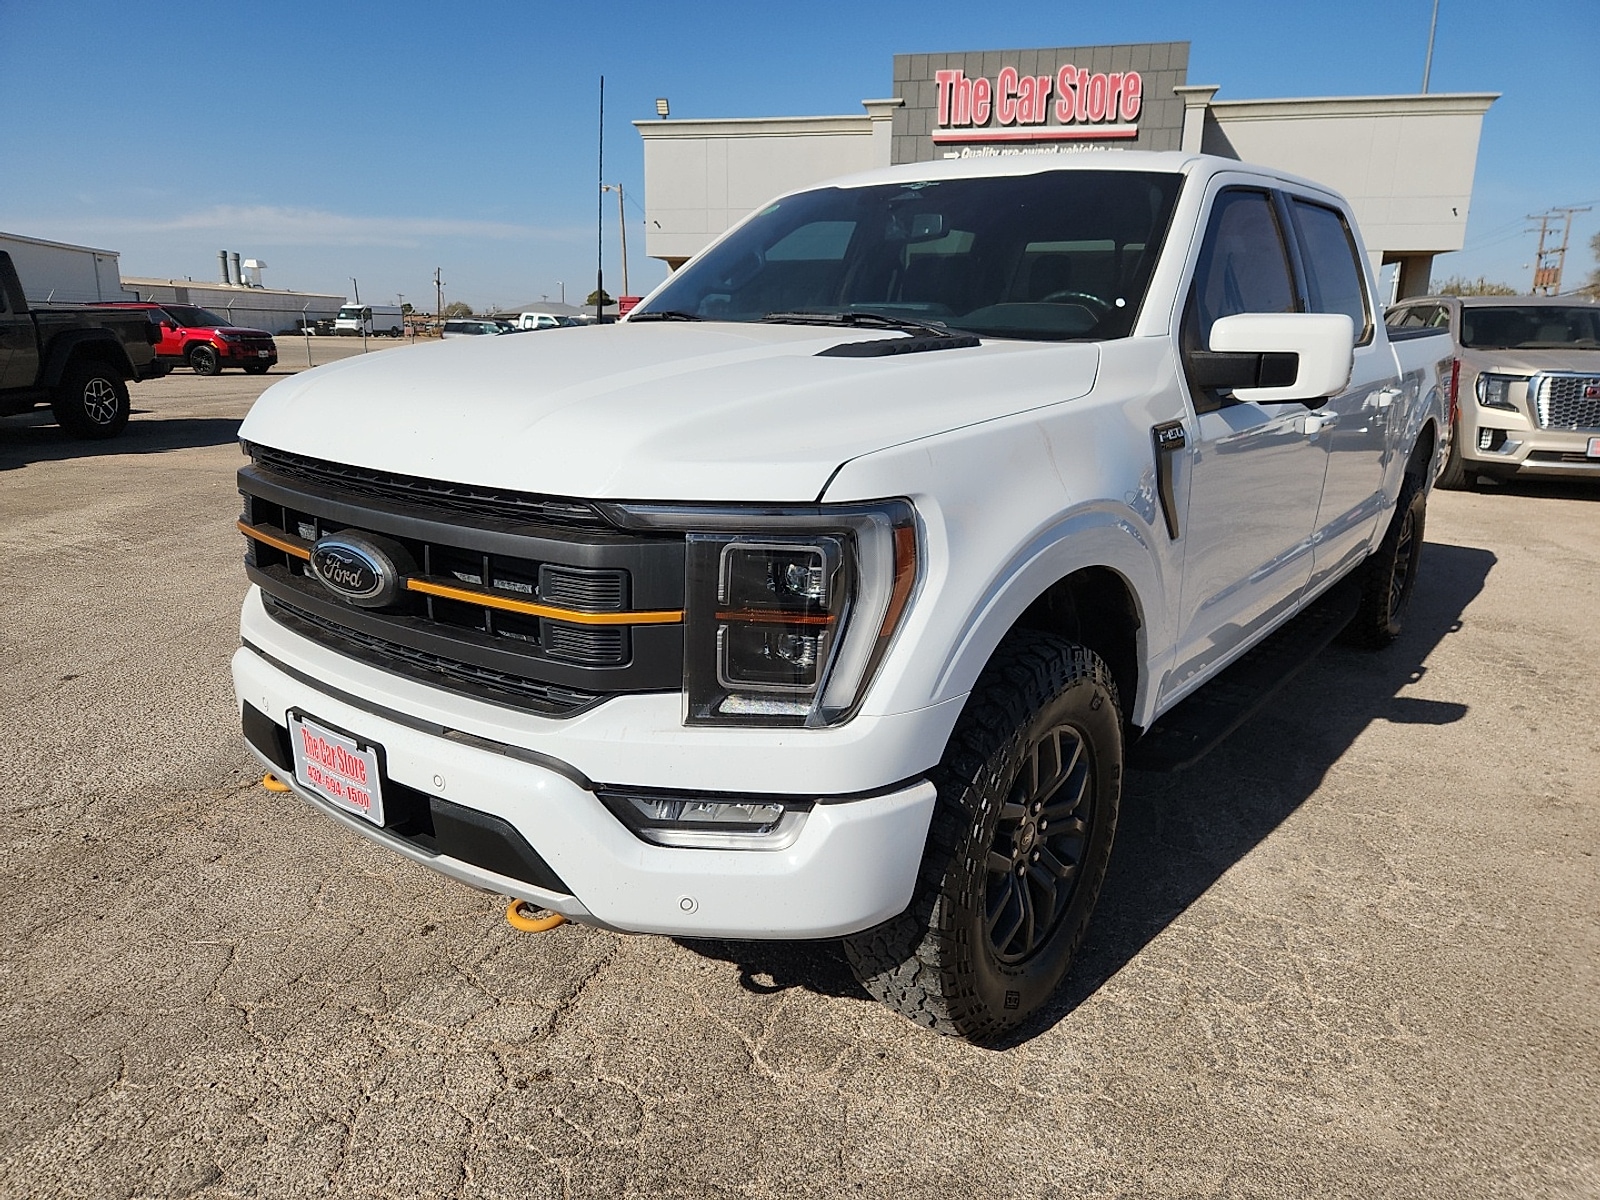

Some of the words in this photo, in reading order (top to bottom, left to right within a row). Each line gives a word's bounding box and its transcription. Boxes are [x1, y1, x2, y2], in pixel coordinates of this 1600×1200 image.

[935, 69, 992, 126] The
[996, 66, 1052, 125] Car
[1055, 64, 1143, 123] Store
[961, 146, 1000, 159] Quality
[323, 553, 363, 587] Ford
[302, 728, 319, 760] The
[318, 736, 336, 768] Car
[336, 745, 367, 784] Store
